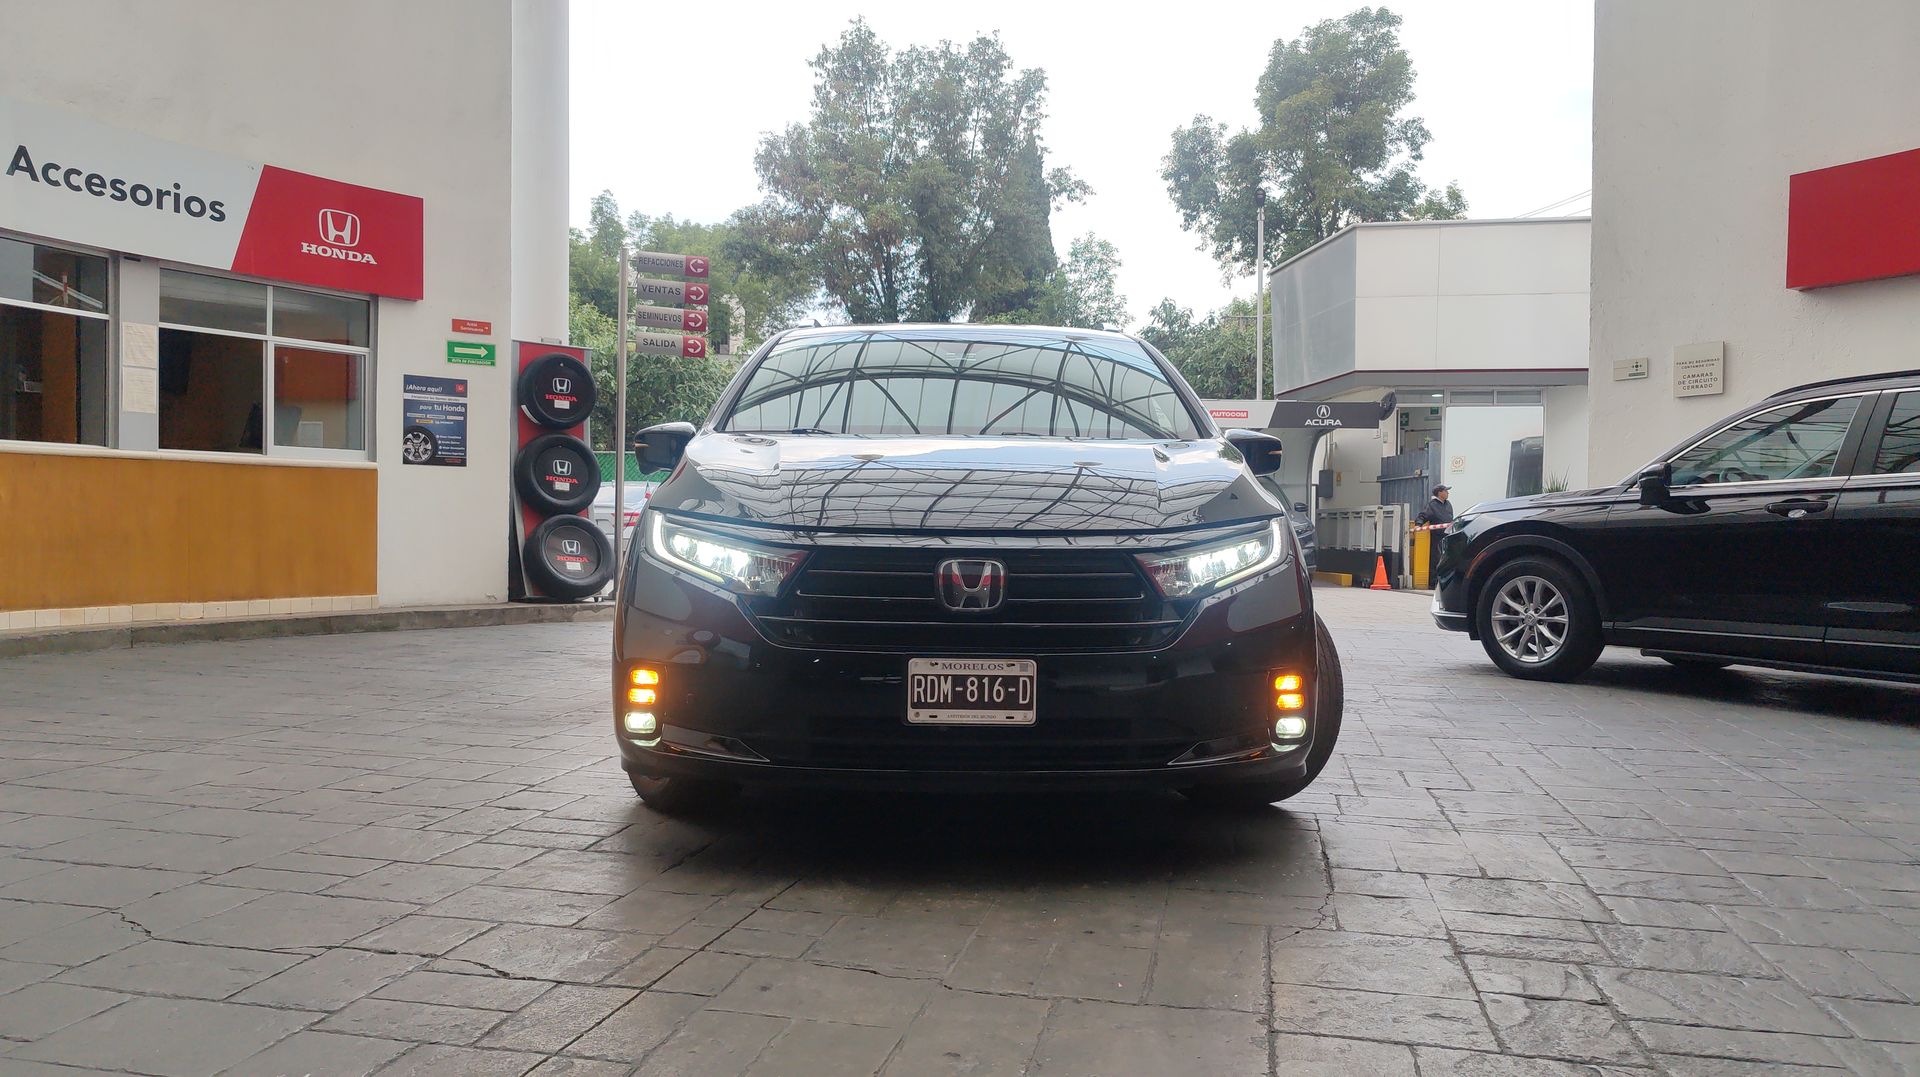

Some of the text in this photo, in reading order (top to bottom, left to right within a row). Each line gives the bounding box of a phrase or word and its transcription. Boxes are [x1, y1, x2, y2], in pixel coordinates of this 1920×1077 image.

[6, 144, 226, 222] Accesorios
[301, 242, 378, 265] HONDA
[638, 257, 683, 268] REFACCIONES
[641, 284, 681, 296] VENTAS
[637, 311, 682, 322] SEMINUEVOS
[643, 338, 676, 348] SALIDA
[1688, 377, 1718, 385] CIRCUITO
[545, 394, 577, 402] HONDA
[442, 404, 465, 412] Honda
[545, 475, 578, 483] HONDA
[941, 662, 1005, 671] MORELOS
[913, 675, 1031, 704] RDM-816-D
